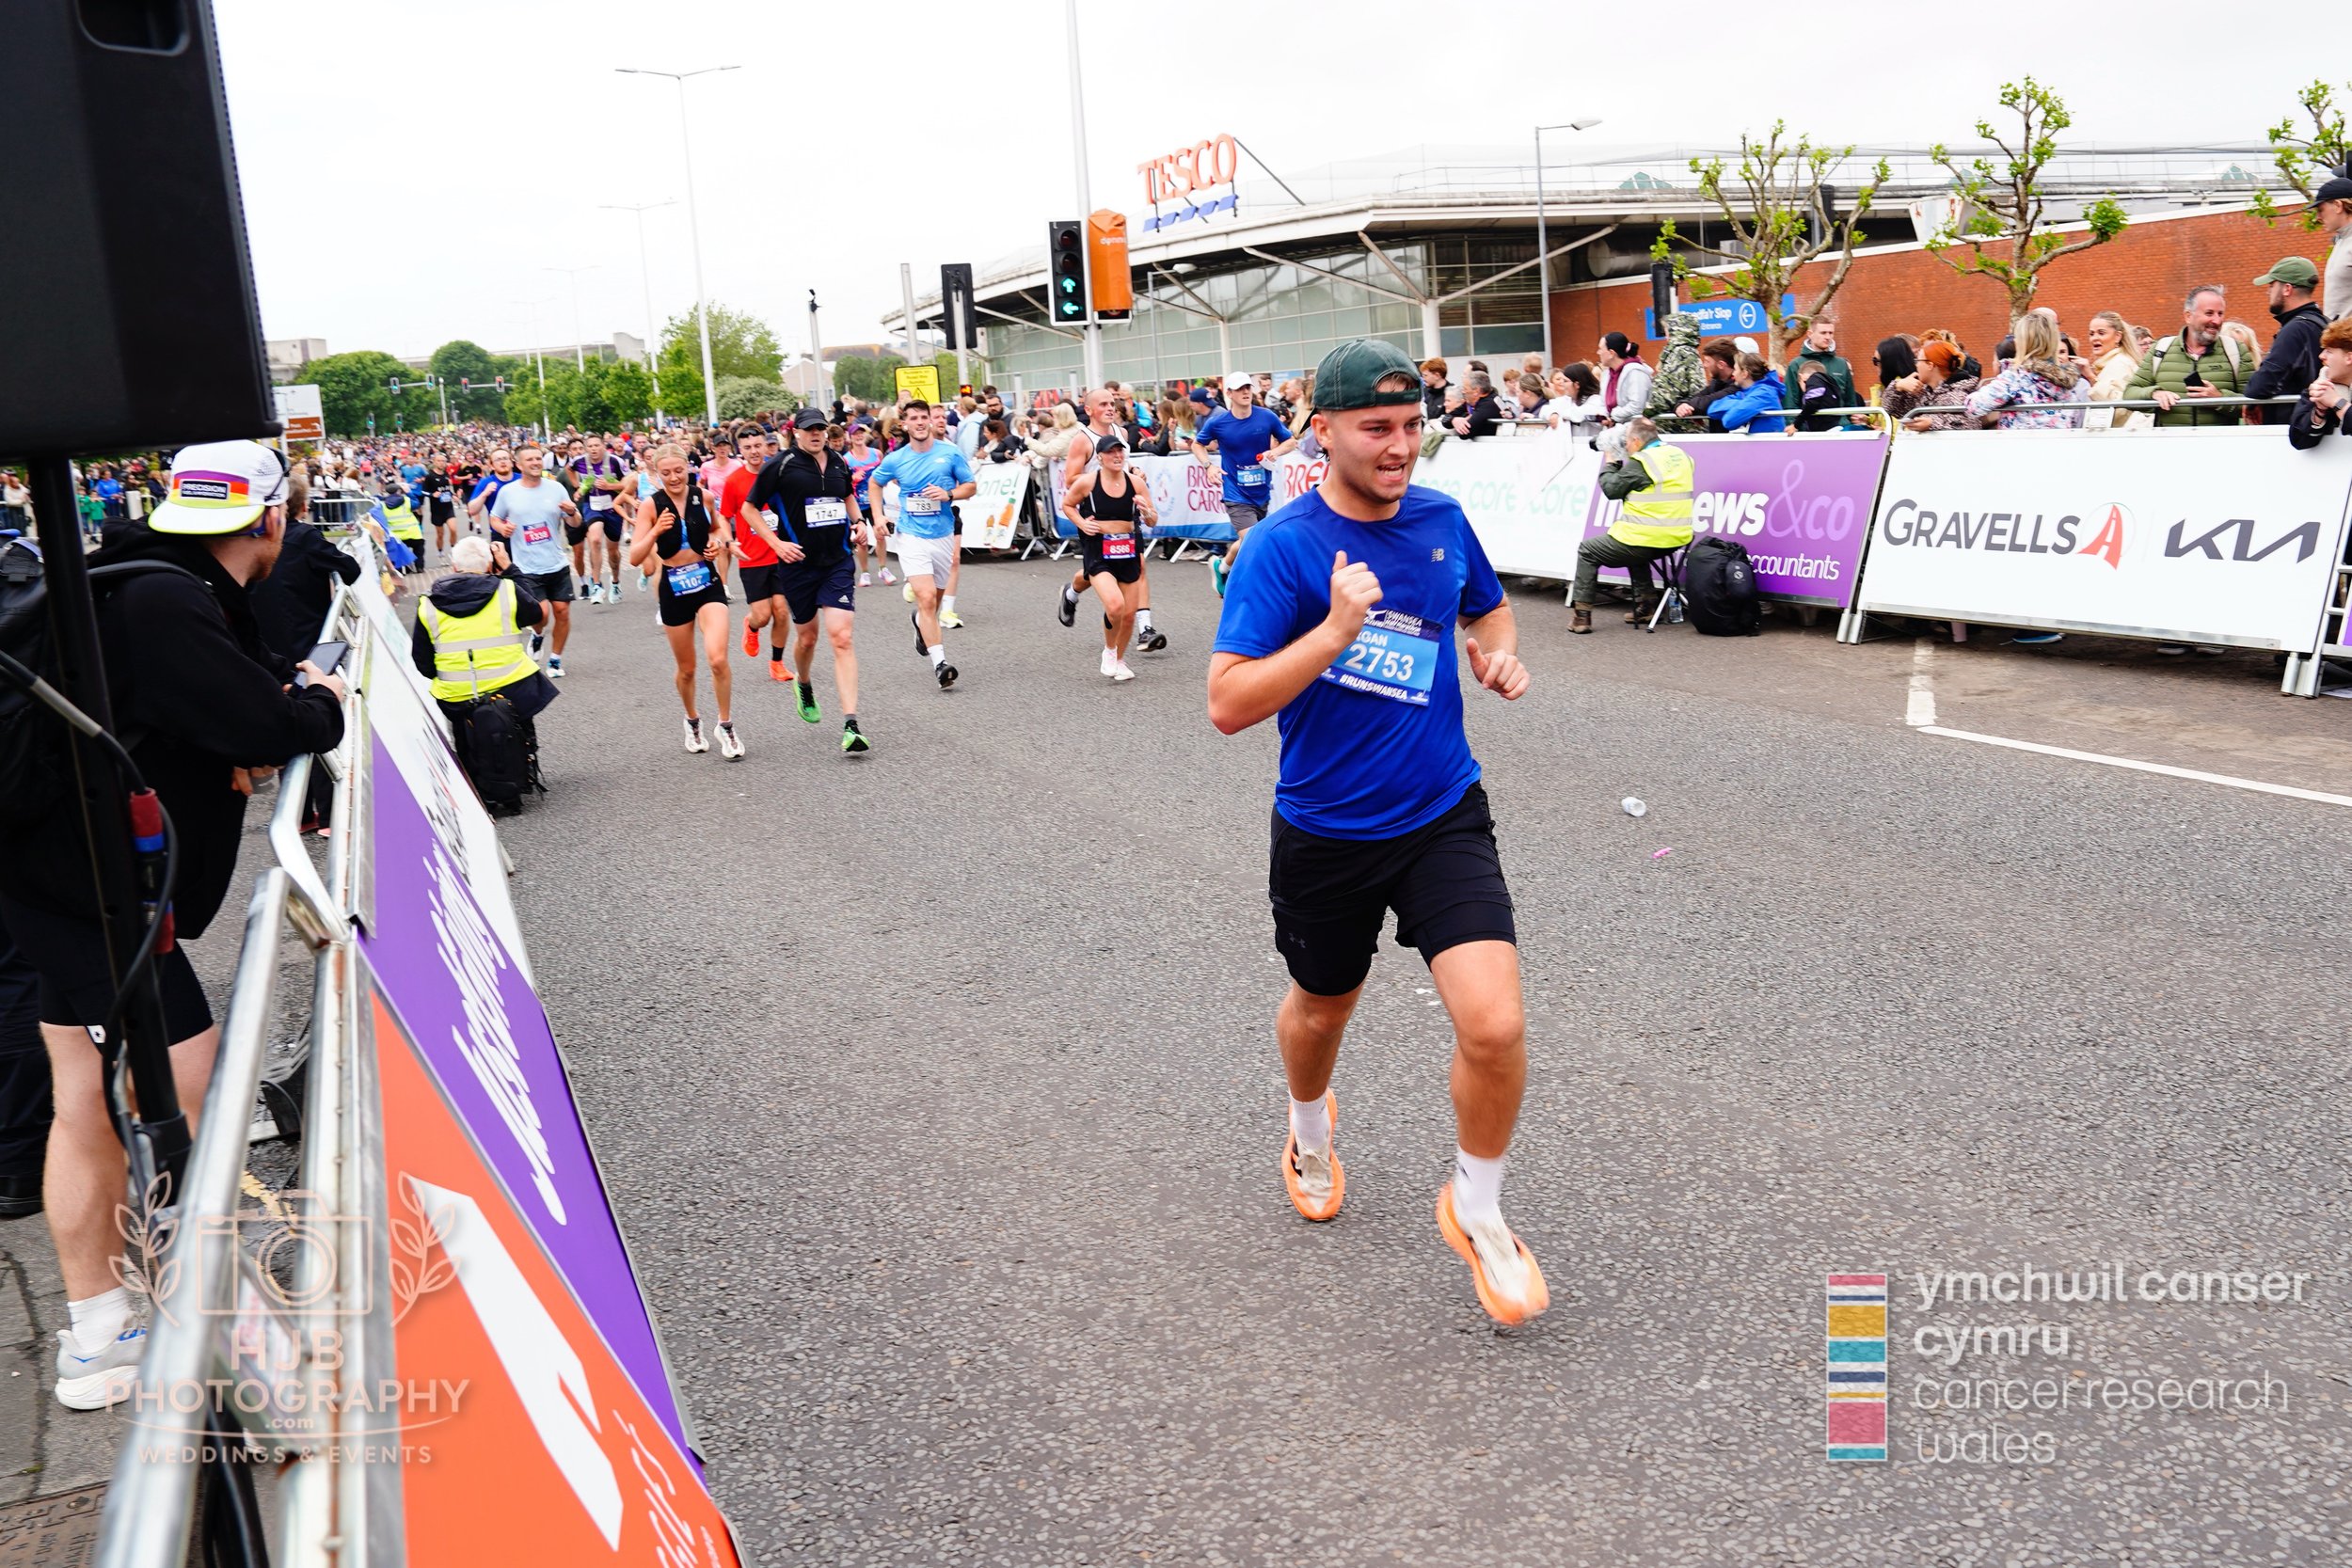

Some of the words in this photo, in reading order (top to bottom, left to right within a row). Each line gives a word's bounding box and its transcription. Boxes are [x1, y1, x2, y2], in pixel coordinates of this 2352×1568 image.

[1137, 133, 1237, 205] TESCO
[977, 471, 1021, 499] one!
[816, 509, 838, 519] 1747
[915, 501, 932, 511] 783
[1883, 499, 2082, 556] GRAVELLS
[2164, 518, 2322, 564] KIA
[678, 575, 704, 589] 1107
[1344, 642, 1415, 682] 2753
[1339, 673, 1408, 701] #RUNSWANSEA
[421, 835, 567, 1227] JustGiving
